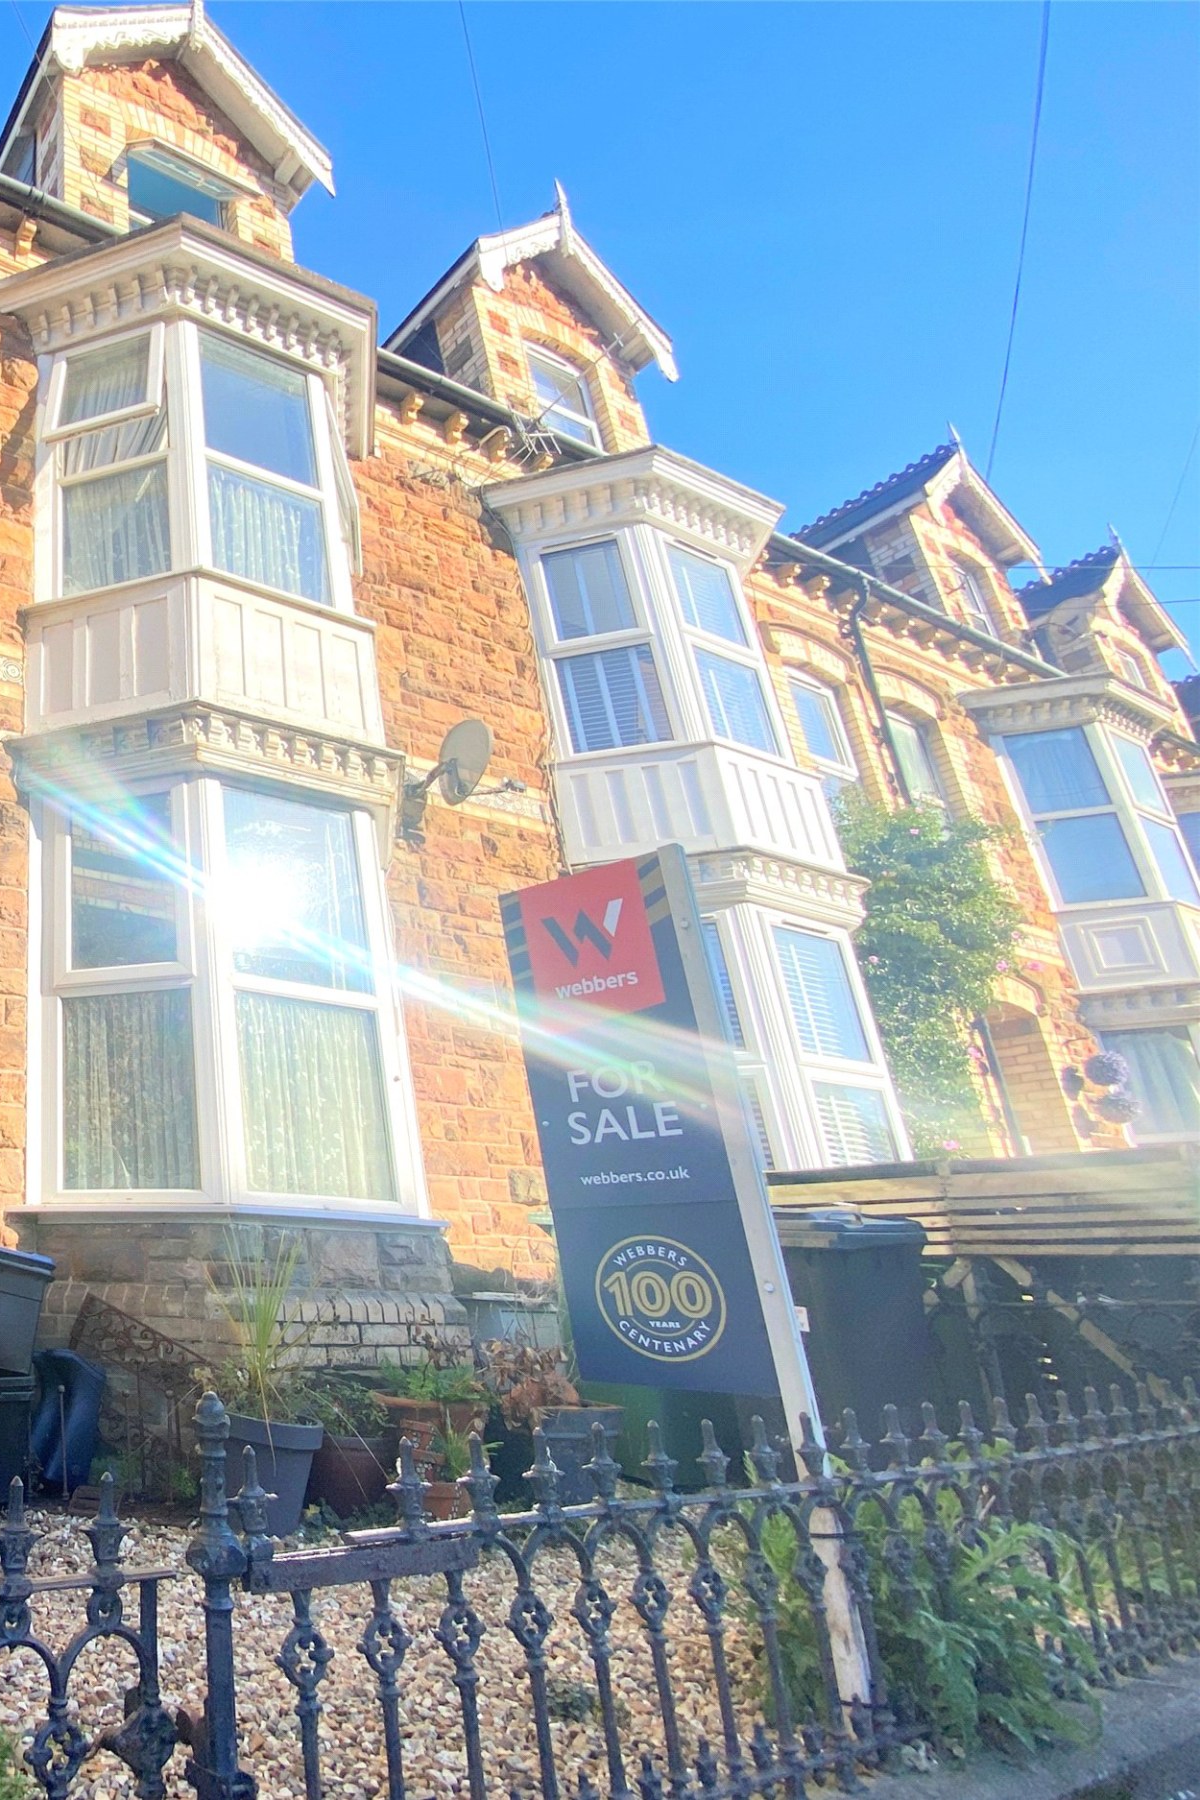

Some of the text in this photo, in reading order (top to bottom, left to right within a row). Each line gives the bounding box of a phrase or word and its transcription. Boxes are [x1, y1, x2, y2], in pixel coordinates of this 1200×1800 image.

[555, 970, 639, 1000] webbers
[567, 1060, 665, 1103] FOR
[567, 1101, 684, 1145] SALE
[580, 1165, 690, 1187] webbers.co.uk
[613, 1244, 687, 1267] WEBBERS
[603, 1270, 713, 1319] 100
[618, 1320, 711, 1353] CENTENARY
[649, 1320, 681, 1329] YEARS
